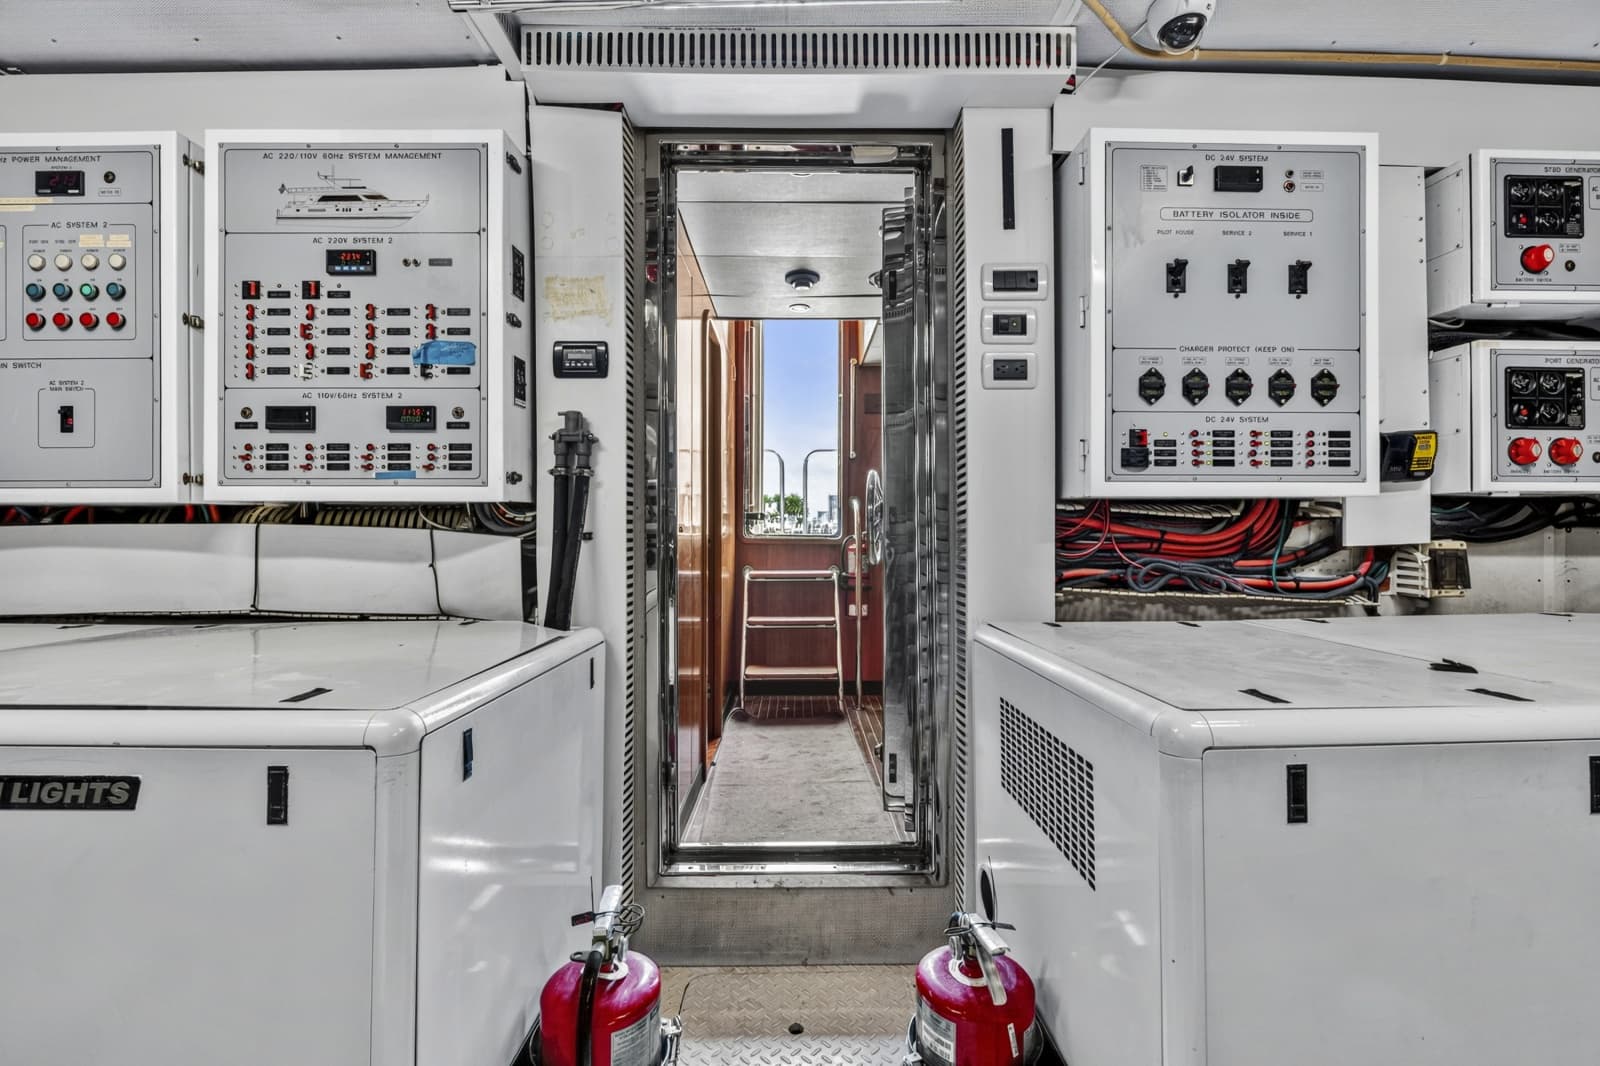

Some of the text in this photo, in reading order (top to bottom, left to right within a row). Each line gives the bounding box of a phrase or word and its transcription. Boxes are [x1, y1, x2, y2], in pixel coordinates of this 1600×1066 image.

[1173, 210, 1300, 220] BATTERY ISOLATOR INSIDE
[10, 781, 131, 805] LIGHTS
